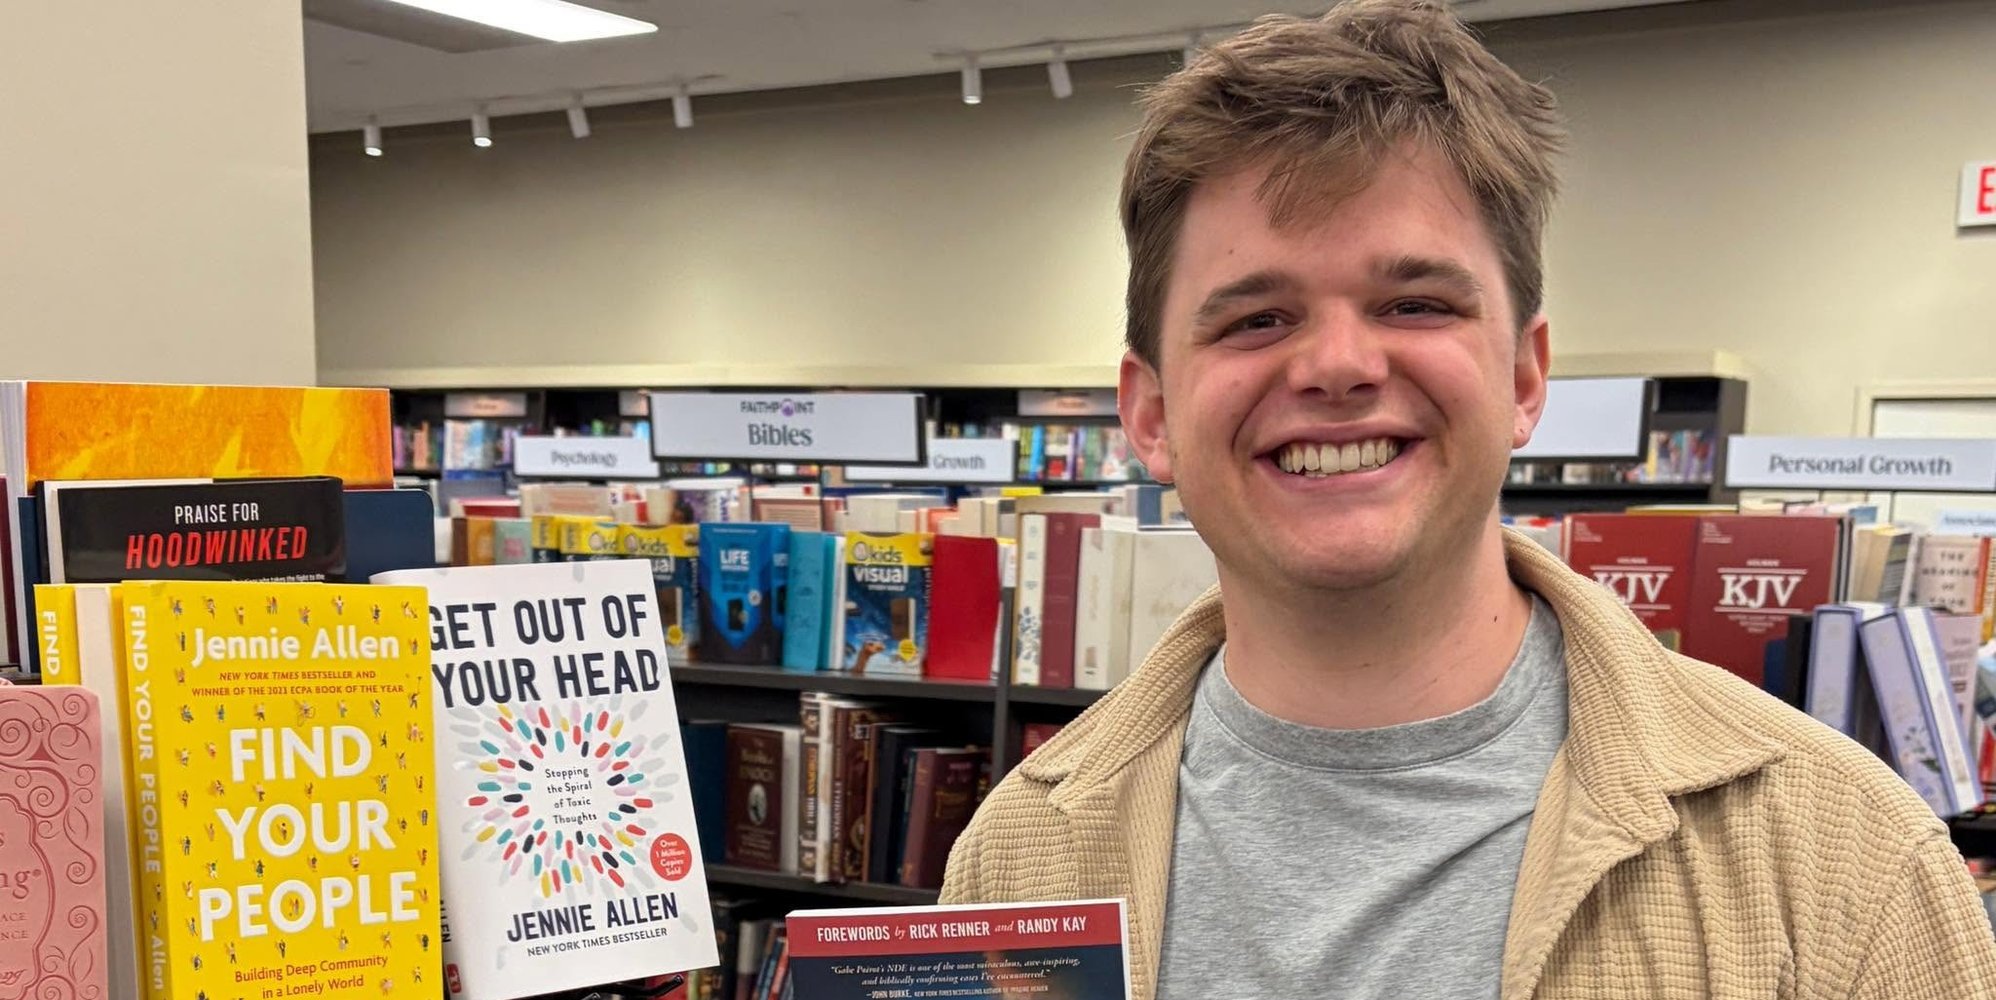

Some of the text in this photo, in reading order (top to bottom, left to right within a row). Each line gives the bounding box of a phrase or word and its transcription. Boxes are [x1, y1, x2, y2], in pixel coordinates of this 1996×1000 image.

[748, 424, 813, 446] Bibles
[551, 450, 617, 468] Psychology
[932, 455, 986, 470] Growth
[1768, 454, 1953, 476] Personal Growth
[174, 502, 260, 525] PRAISE FOR
[125, 526, 308, 570] HOODWINKED
[720, 550, 750, 565] LIFE
[869, 545, 904, 563] kids
[853, 564, 909, 584] visual
[1718, 574, 1803, 609] KJV
[428, 594, 648, 652] GET OUT OF
[42, 610, 61, 676] FIND
[191, 624, 400, 668] Jennie Allen
[219, 670, 376, 681] NEW YORK TIMES BESTSELLER AND
[432, 648, 661, 709] YOUR HEAD
[192, 687, 230, 697] WINNER
[233, 687, 245, 696] OF
[248, 687, 264, 695] THE
[290, 686, 313, 694] ECPA
[315, 685, 342, 694] BOOK
[345, 685, 358, 694] OF
[359, 685, 379, 693] THE
[380, 684, 405, 693] YEAR
[130, 605, 162, 874] FIND YOUR PEOPLE
[229, 725, 373, 783] FIND
[545, 766, 590, 779] Stopping
[547, 781, 593, 795] the Spiral
[554, 796, 592, 809] of Toxic
[553, 811, 598, 826] Thoughts
[215, 799, 397, 861] YOUR
[660, 839, 678, 848] Over
[660, 847, 686, 858] Million
[659, 857, 684, 869] Copies
[665, 866, 682, 877] Sold
[198, 870, 421, 942] PEOPLE
[506, 892, 679, 943] JENNIE ALLEN
[816, 916, 1087, 942] FOREWORDS by RICK RENNER and RANDY KAY
[527, 928, 668, 957] NEW YORK TIMES BESTSELLER
[151, 935, 167, 990] Allen
[235, 955, 389, 983] Building Deep Community
[887, 963, 908, 973] NDE
[943, 961, 955, 970] the
[262, 975, 365, 999] in a Lonely World
[861, 976, 878, 986] and
